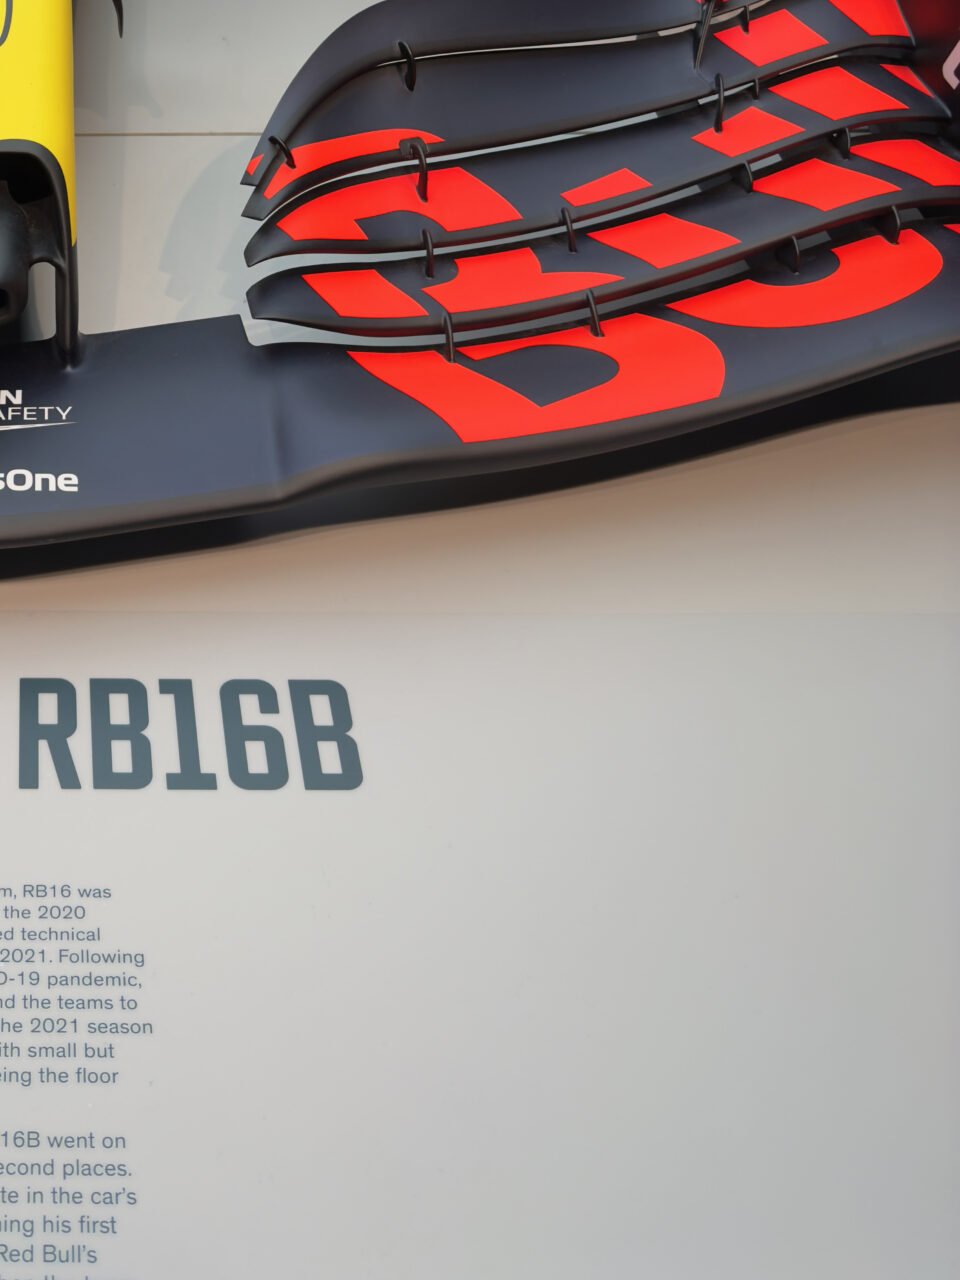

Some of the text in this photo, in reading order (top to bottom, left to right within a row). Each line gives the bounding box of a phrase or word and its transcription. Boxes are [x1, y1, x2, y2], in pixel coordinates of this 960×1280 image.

[18, 677, 365, 791] RB16B
[22, 884, 72, 898] RB16
[77, 887, 112, 899] was
[3, 905, 32, 920] the
[37, 905, 86, 920] 2020
[20, 927, 101, 942] technical
[0, 948, 54, 965] 2021.
[57, 948, 146, 969] Following
[47, 971, 142, 990] pandemic,
[30, 1017, 77, 1034] 2021
[87, 1022, 153, 1035] season
[37, 1067, 69, 1084] the
[75, 1067, 119, 1084] floor
[46, 1131, 96, 1149] went
[101, 1136, 126, 1149] on
[62, 1158, 132, 1181] places.
[27, 1186, 44, 1204] in
[50, 1186, 83, 1205] the
[90, 1187, 138, 1206] car’s
[42, 1215, 72, 1234] his
[78, 1214, 118, 1235] first
[42, 1244, 98, 1264] Bull’s
